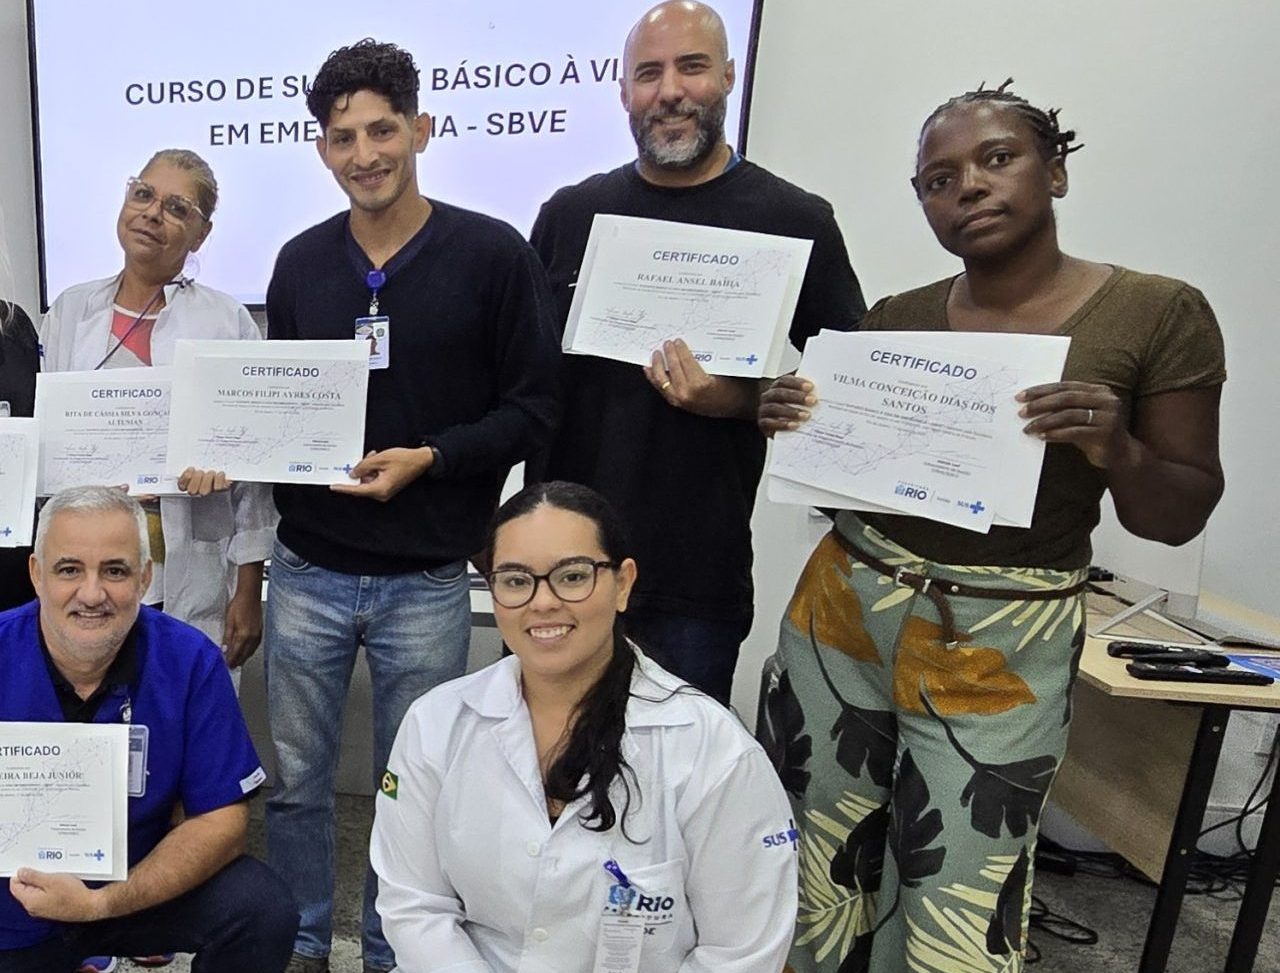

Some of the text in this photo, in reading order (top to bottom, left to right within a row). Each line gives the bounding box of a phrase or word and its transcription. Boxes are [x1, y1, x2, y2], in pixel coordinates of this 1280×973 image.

[125, 79, 227, 106] CURSO
[236, 77, 274, 100] DE
[432, 59, 552, 92] BÁSICO
[559, 56, 581, 86] À
[210, 124, 250, 146] EM
[486, 109, 567, 136] SBVE
[653, 250, 739, 265] CERTIFICADO
[242, 366, 320, 378] CERTIFICADO
[870, 350, 977, 380] CERTIFICADO
[91, 389, 162, 399] CERTIFICADO
[833, 373, 866, 388] VILMA
[869, 381, 938, 402] CONCEIÇÃO
[970, 401, 997, 415] DOS
[882, 397, 927, 415] SANTOS
[905, 487, 927, 500] RIO
[762, 832, 788, 848] SUS
[46, 851, 63, 860] RIO
